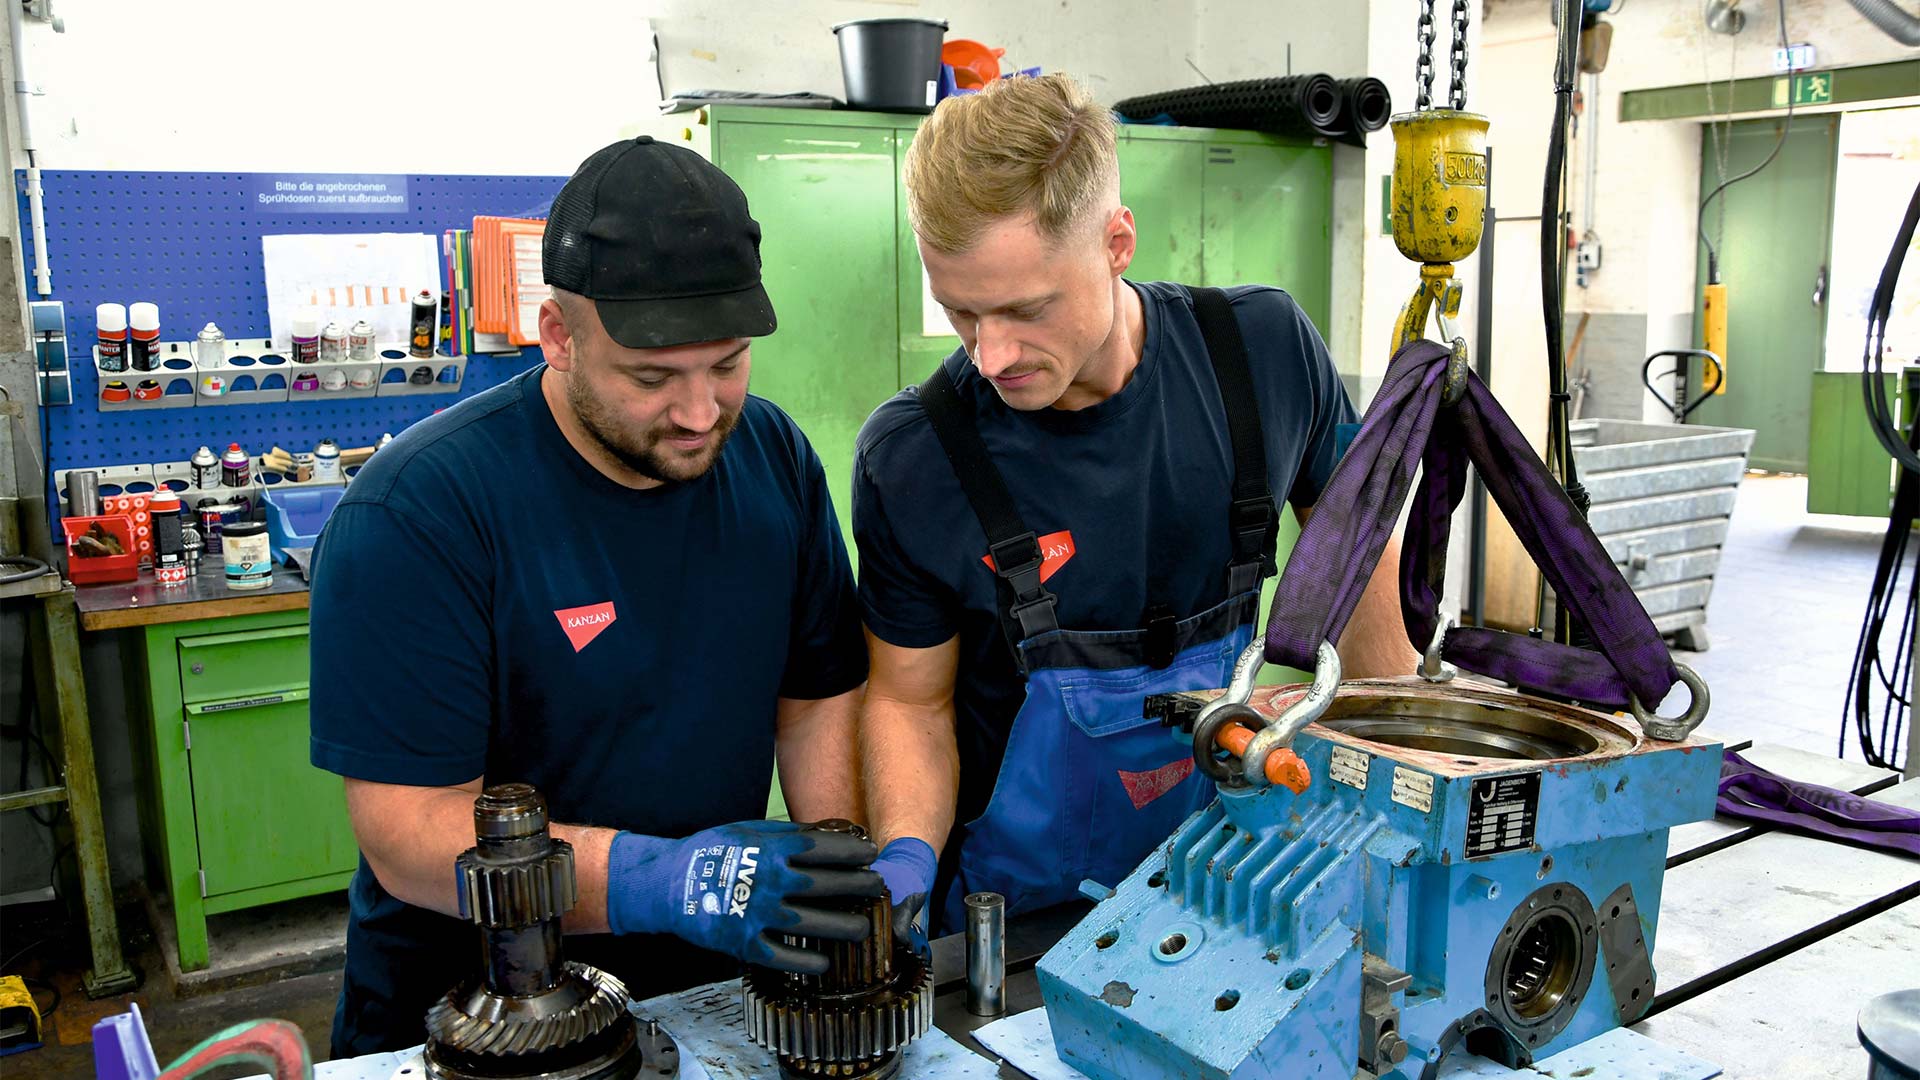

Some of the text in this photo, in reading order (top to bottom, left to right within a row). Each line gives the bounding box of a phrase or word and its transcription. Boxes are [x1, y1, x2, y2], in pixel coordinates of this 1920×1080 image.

[1446, 154, 1486, 185] 500kg
[275, 181, 387, 193] Bitte die angebrochenen
[258, 193, 404, 205] Sprühdosen zuerst aufbrauchen
[567, 612, 611, 628] KANZAN
[1499, 778, 1527, 787] JAGENBERG
[729, 846, 760, 919] uvex
